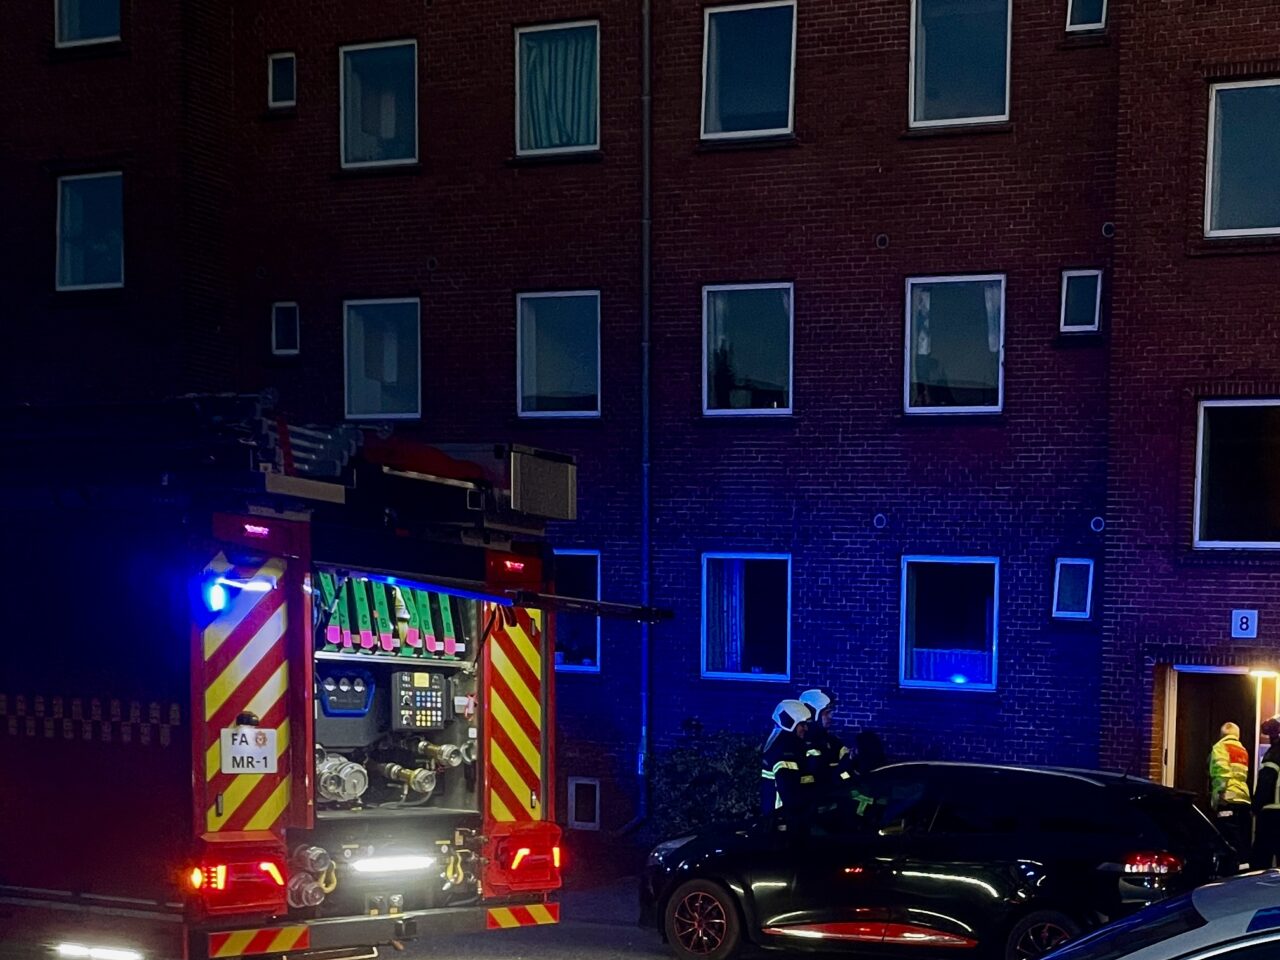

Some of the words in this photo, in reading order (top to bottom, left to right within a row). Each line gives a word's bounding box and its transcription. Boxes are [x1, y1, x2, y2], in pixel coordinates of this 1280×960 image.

[1239, 616, 1249, 631] 8
[231, 733, 249, 746] FA
[231, 755, 268, 769] MR-1
